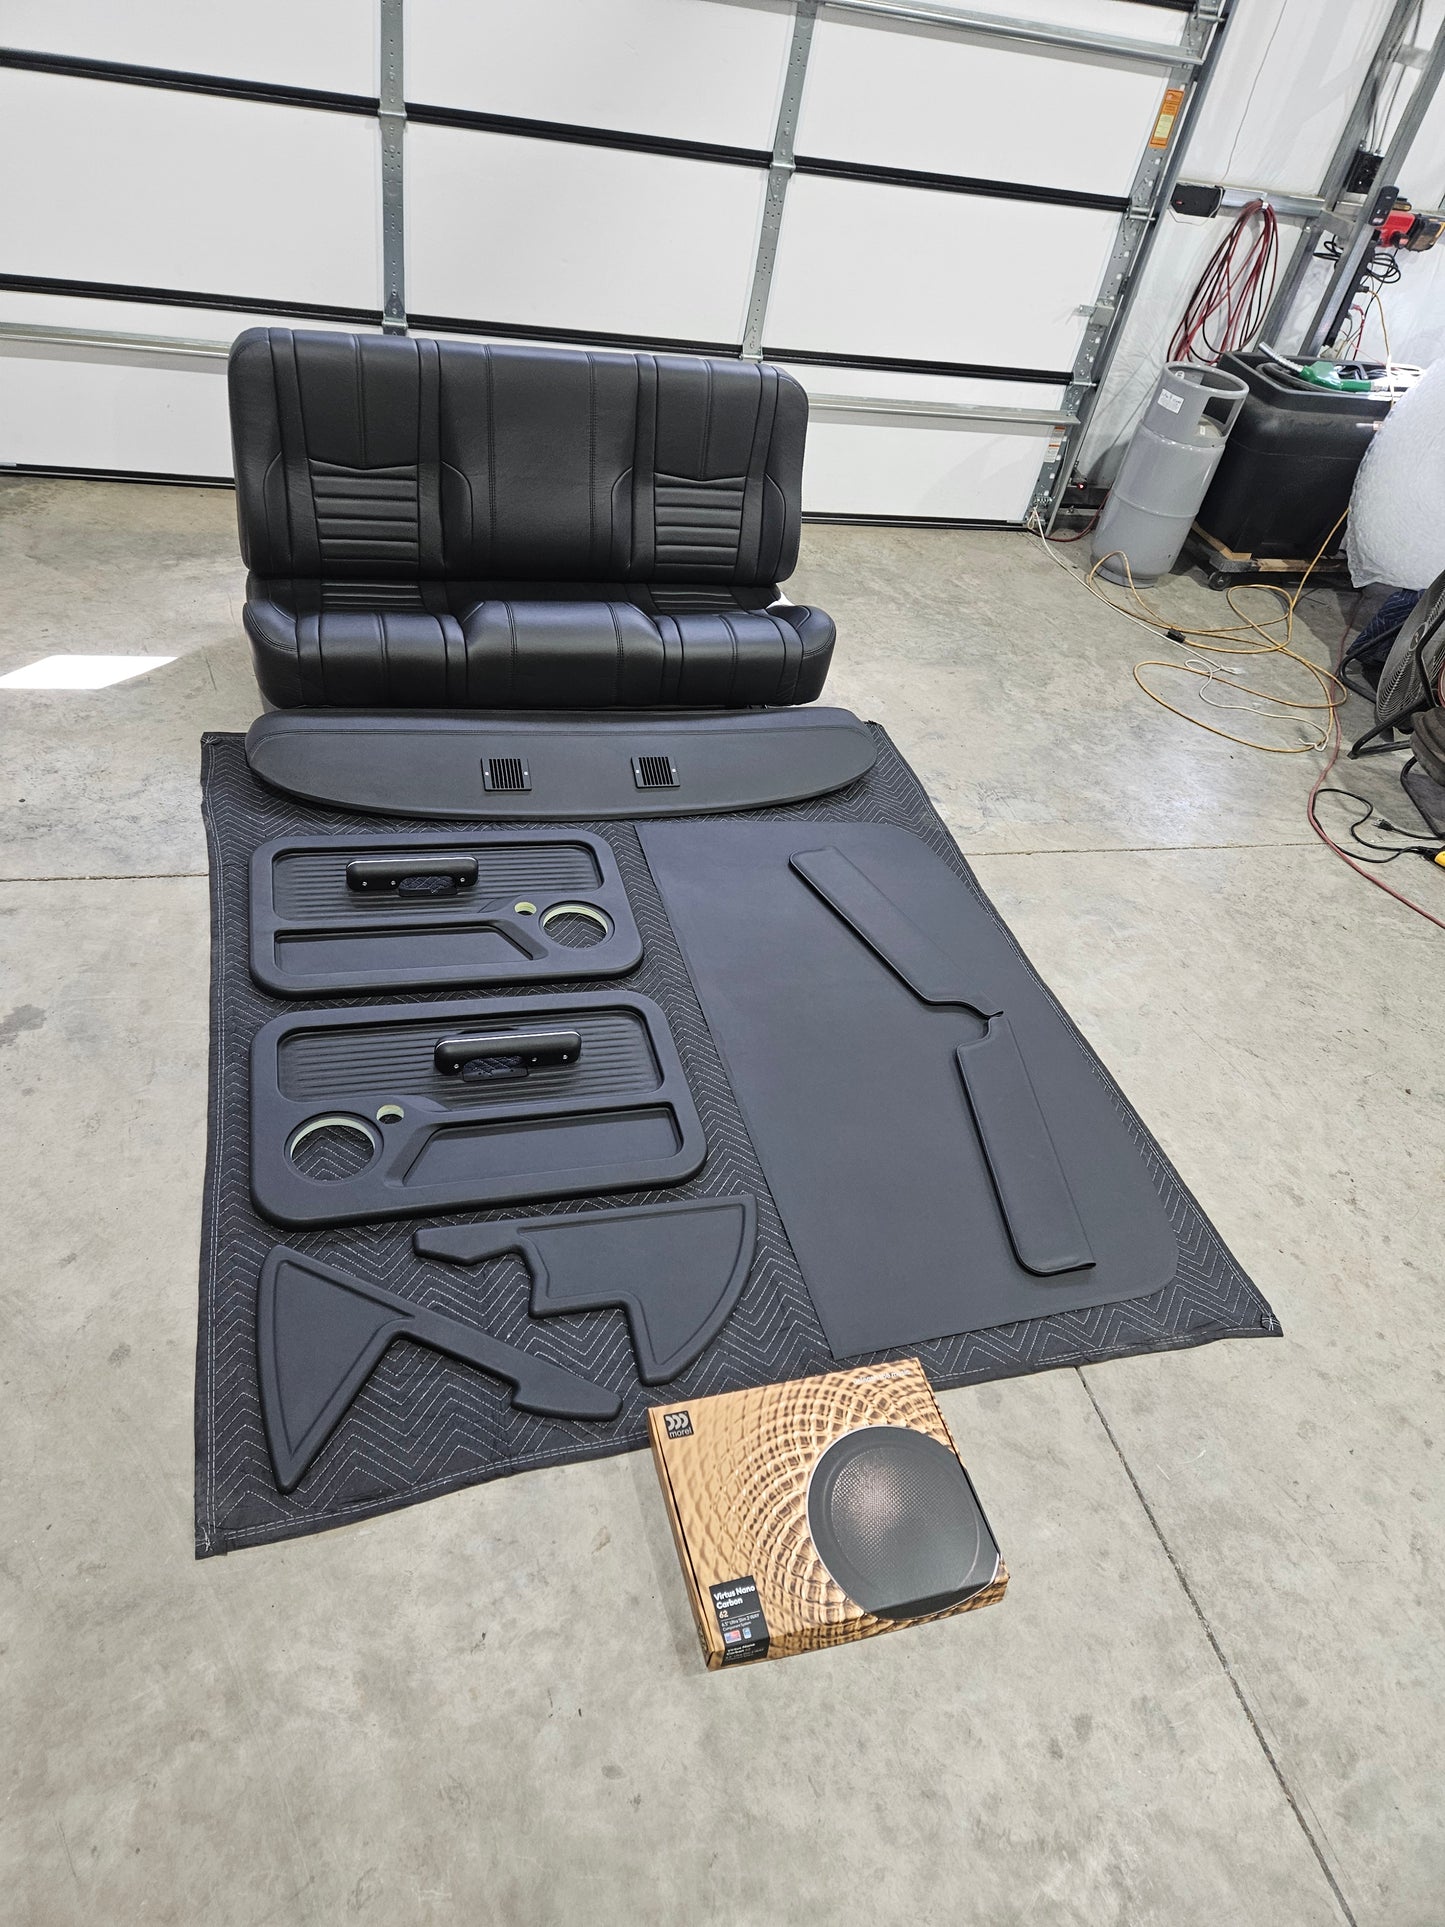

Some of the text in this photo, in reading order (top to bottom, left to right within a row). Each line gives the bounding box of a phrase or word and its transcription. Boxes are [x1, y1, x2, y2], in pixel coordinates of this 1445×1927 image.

[669, 1426, 692, 1438] morel
[713, 1585, 756, 1601] Virtus Nano
[716, 1598, 743, 1610] Carbon
[719, 1610, 729, 1619] 62
